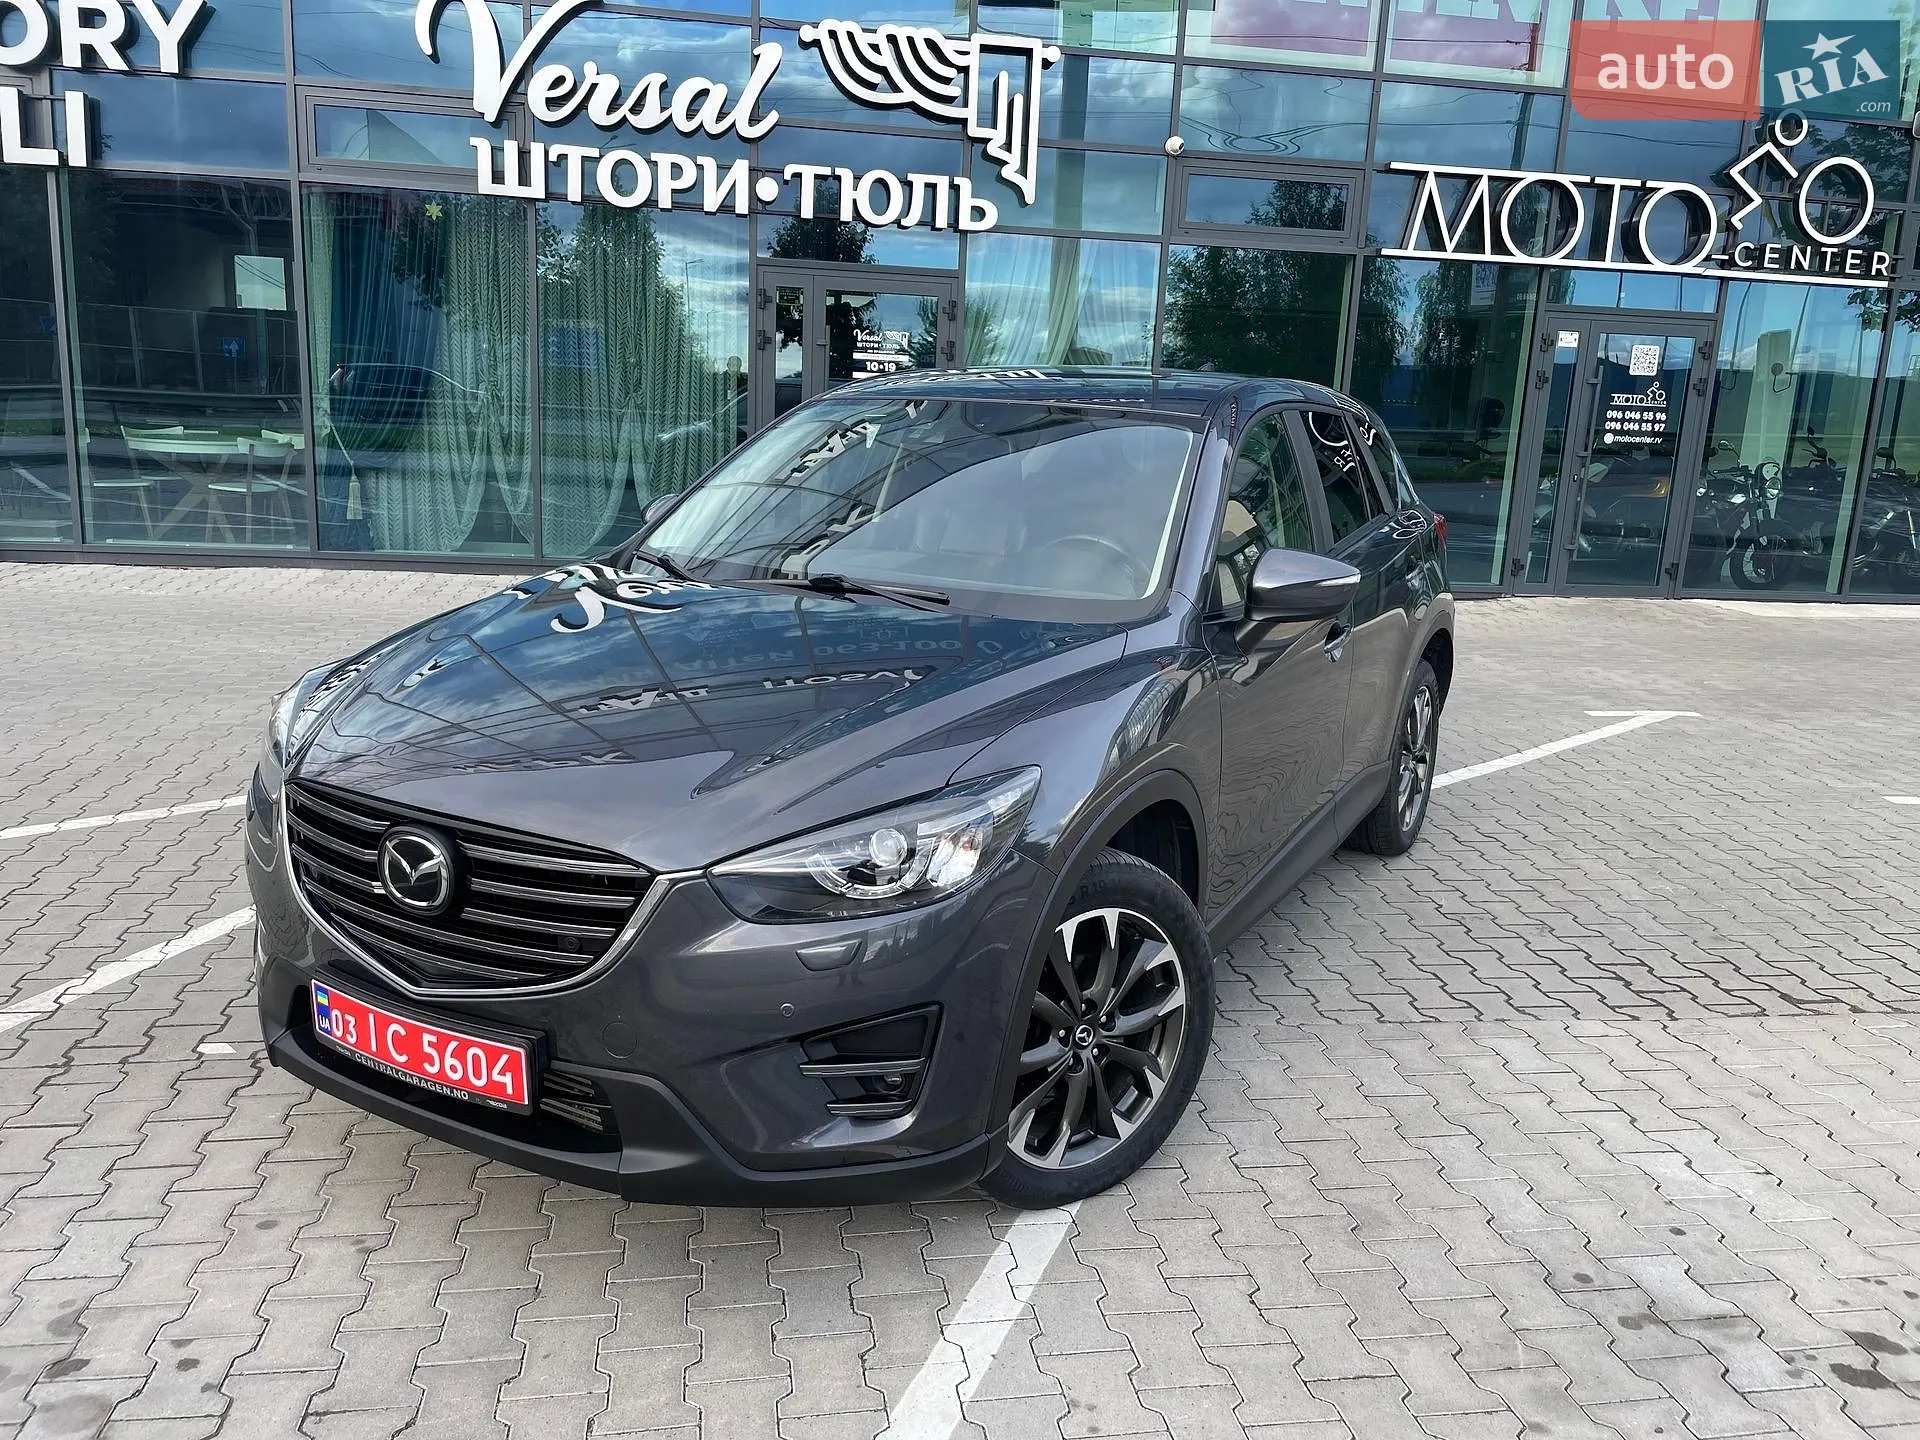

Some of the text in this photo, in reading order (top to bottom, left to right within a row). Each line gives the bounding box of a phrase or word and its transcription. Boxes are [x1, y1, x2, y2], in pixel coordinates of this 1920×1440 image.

[415, 0, 783, 140] Versal
[469, 136, 999, 232] ШТОРИ ТЮЛЬ
[1400, 170, 1718, 270] MOTO
[1605, 421, 1666, 432] 096 046 55 97
[1606, 410, 1667, 421] 096 046 55 96
[318, 1014, 331, 1032] UA
[330, 1008, 358, 1045] 03
[421, 1032, 514, 1096] 5604
[355, 1053, 469, 1101] CENTRALGARAGEN.NO
